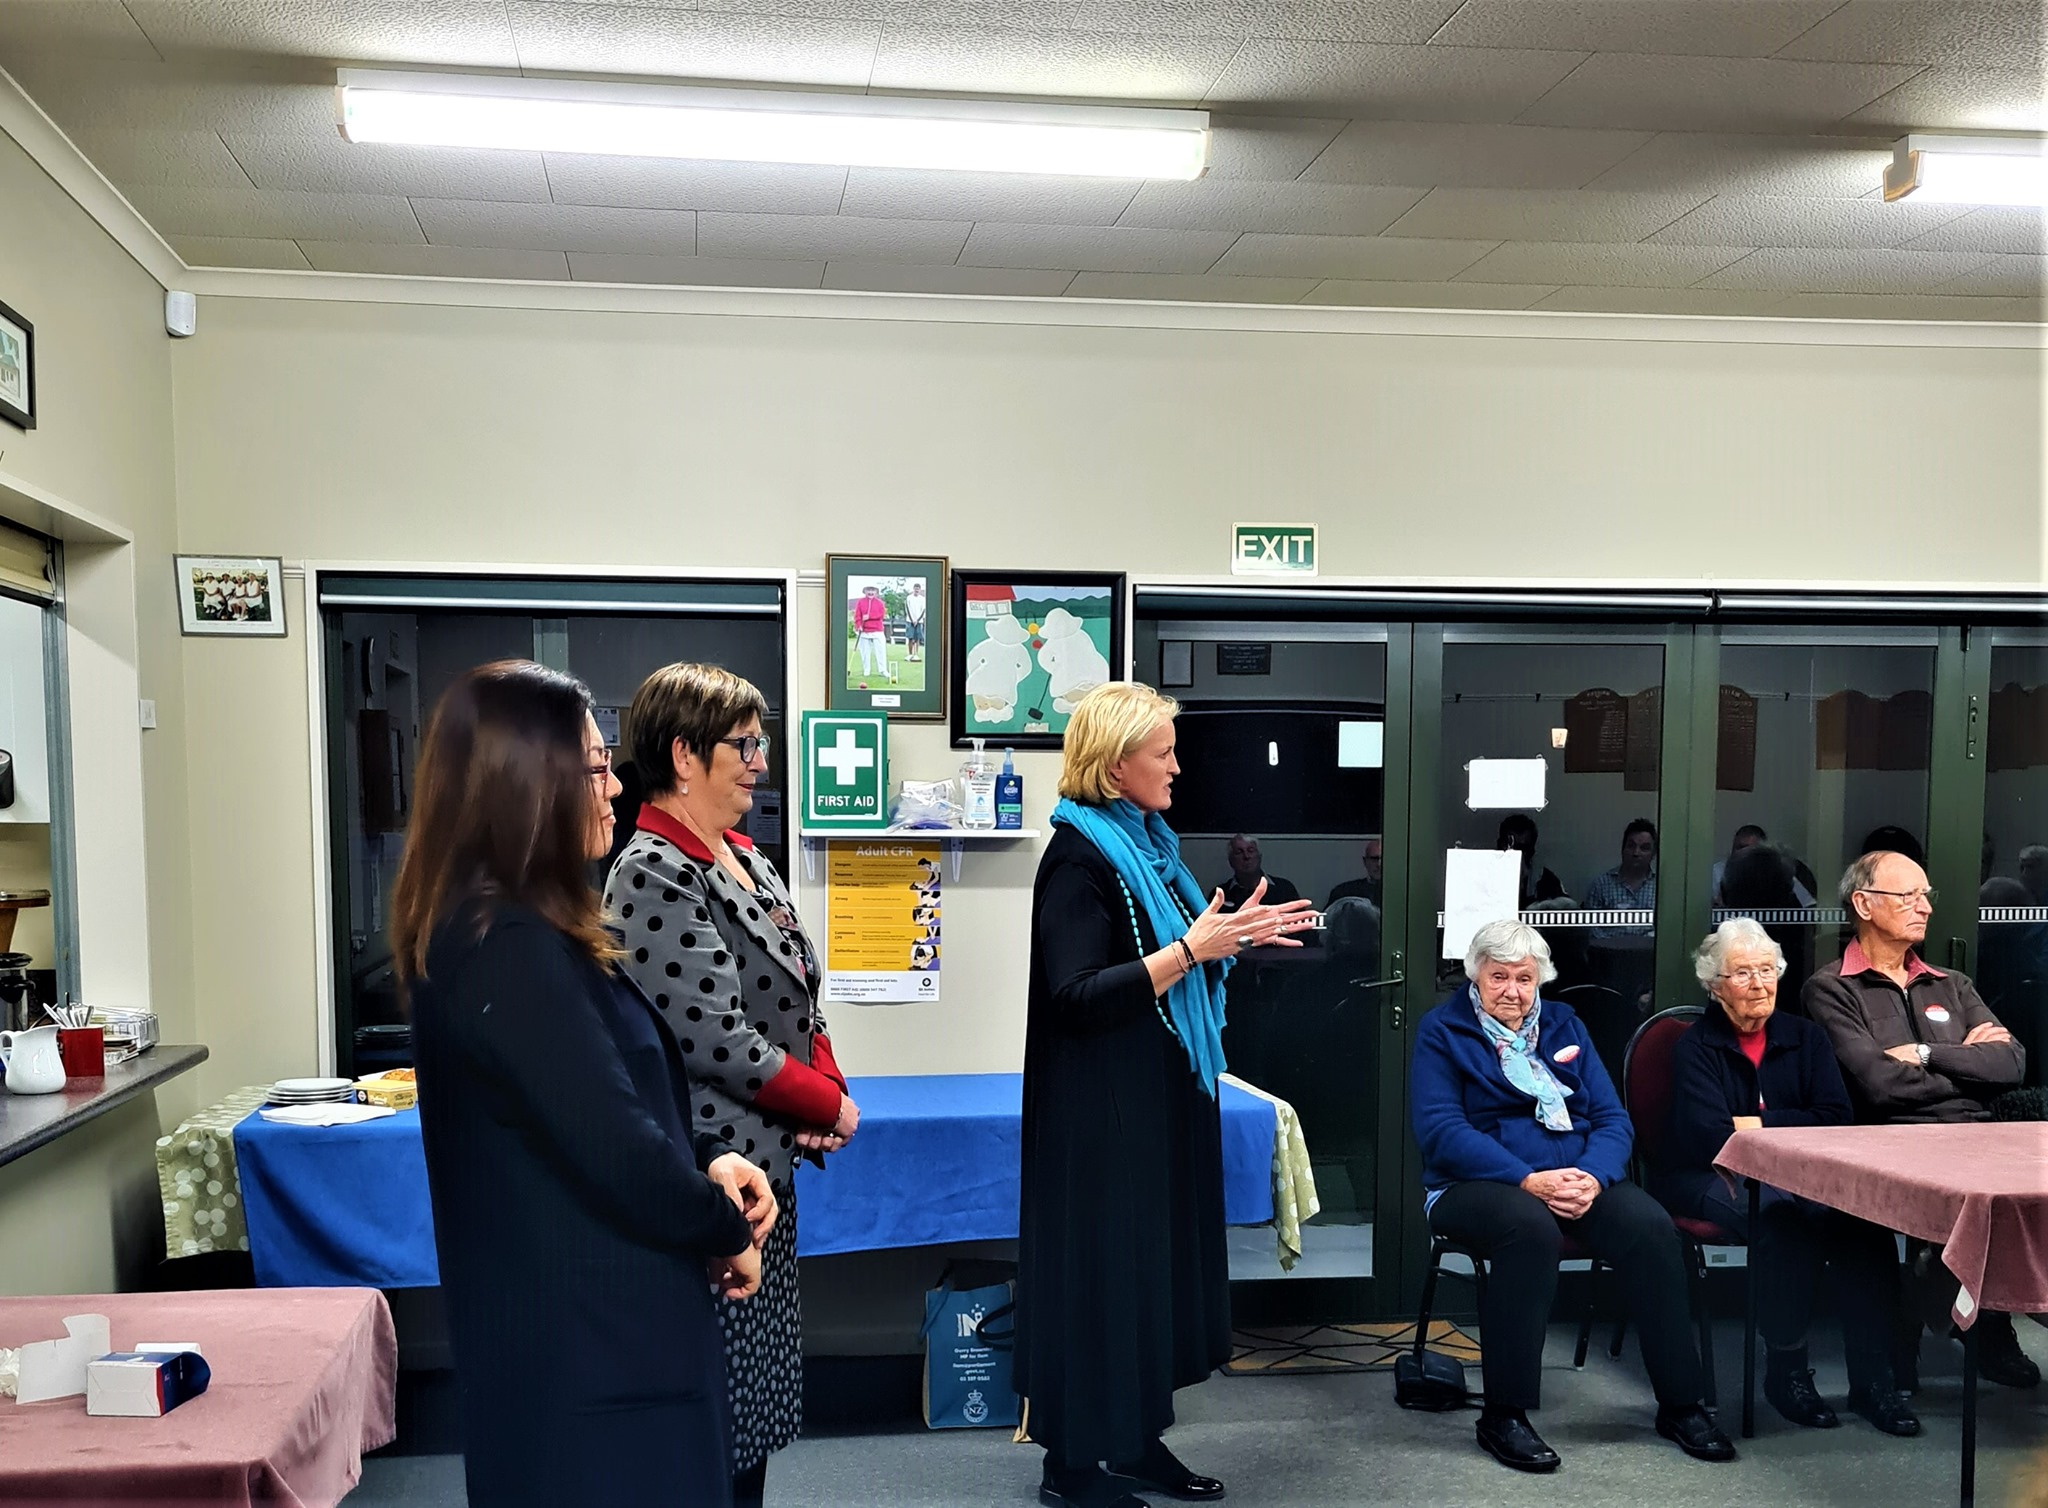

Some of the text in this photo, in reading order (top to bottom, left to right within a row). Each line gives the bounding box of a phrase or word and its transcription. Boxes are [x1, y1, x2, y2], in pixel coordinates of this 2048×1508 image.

[1239, 535, 1312, 562] EXIT
[817, 795, 875, 807] FIRST AID
[855, 846, 914, 857] Adult CPR
